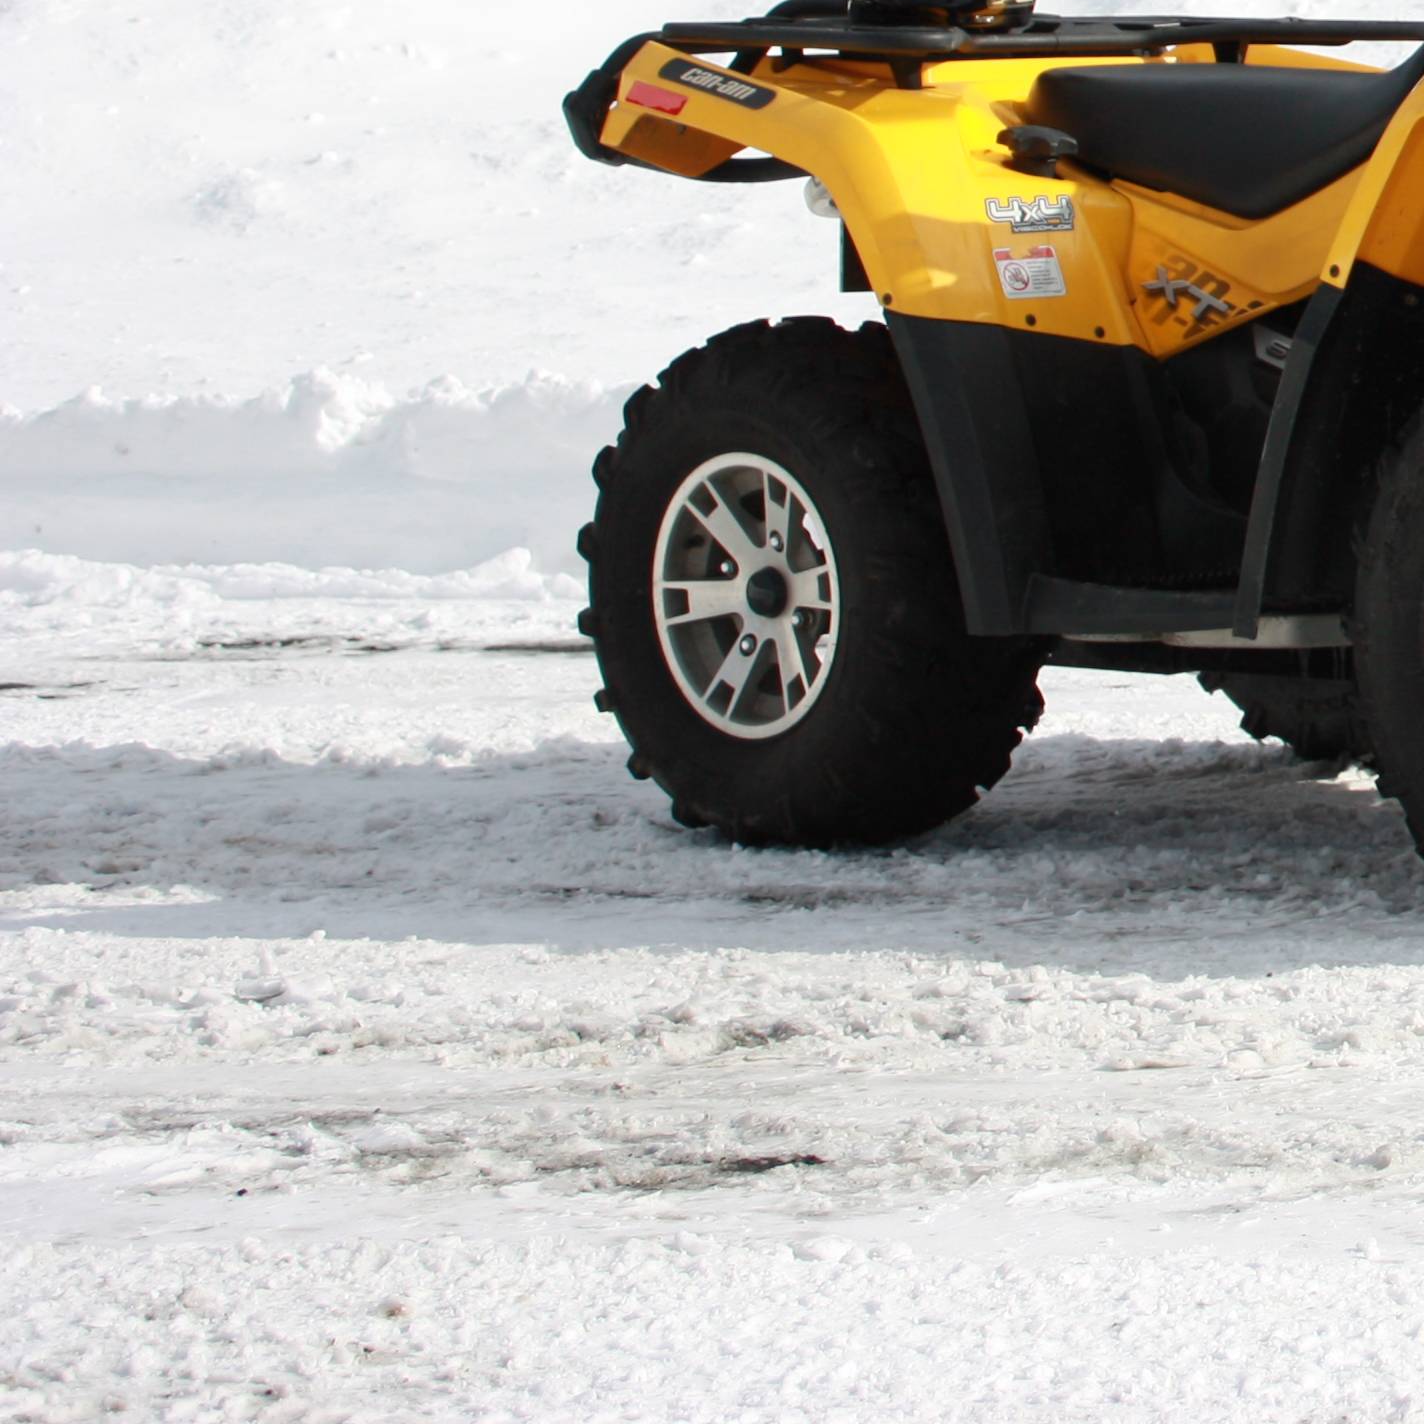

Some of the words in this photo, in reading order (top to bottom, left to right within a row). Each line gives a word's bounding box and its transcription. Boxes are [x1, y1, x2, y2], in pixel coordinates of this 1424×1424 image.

[680, 67, 758, 101] can-am
[985, 195, 1073, 225] 4x4
[1141, 264, 1230, 320] XT
